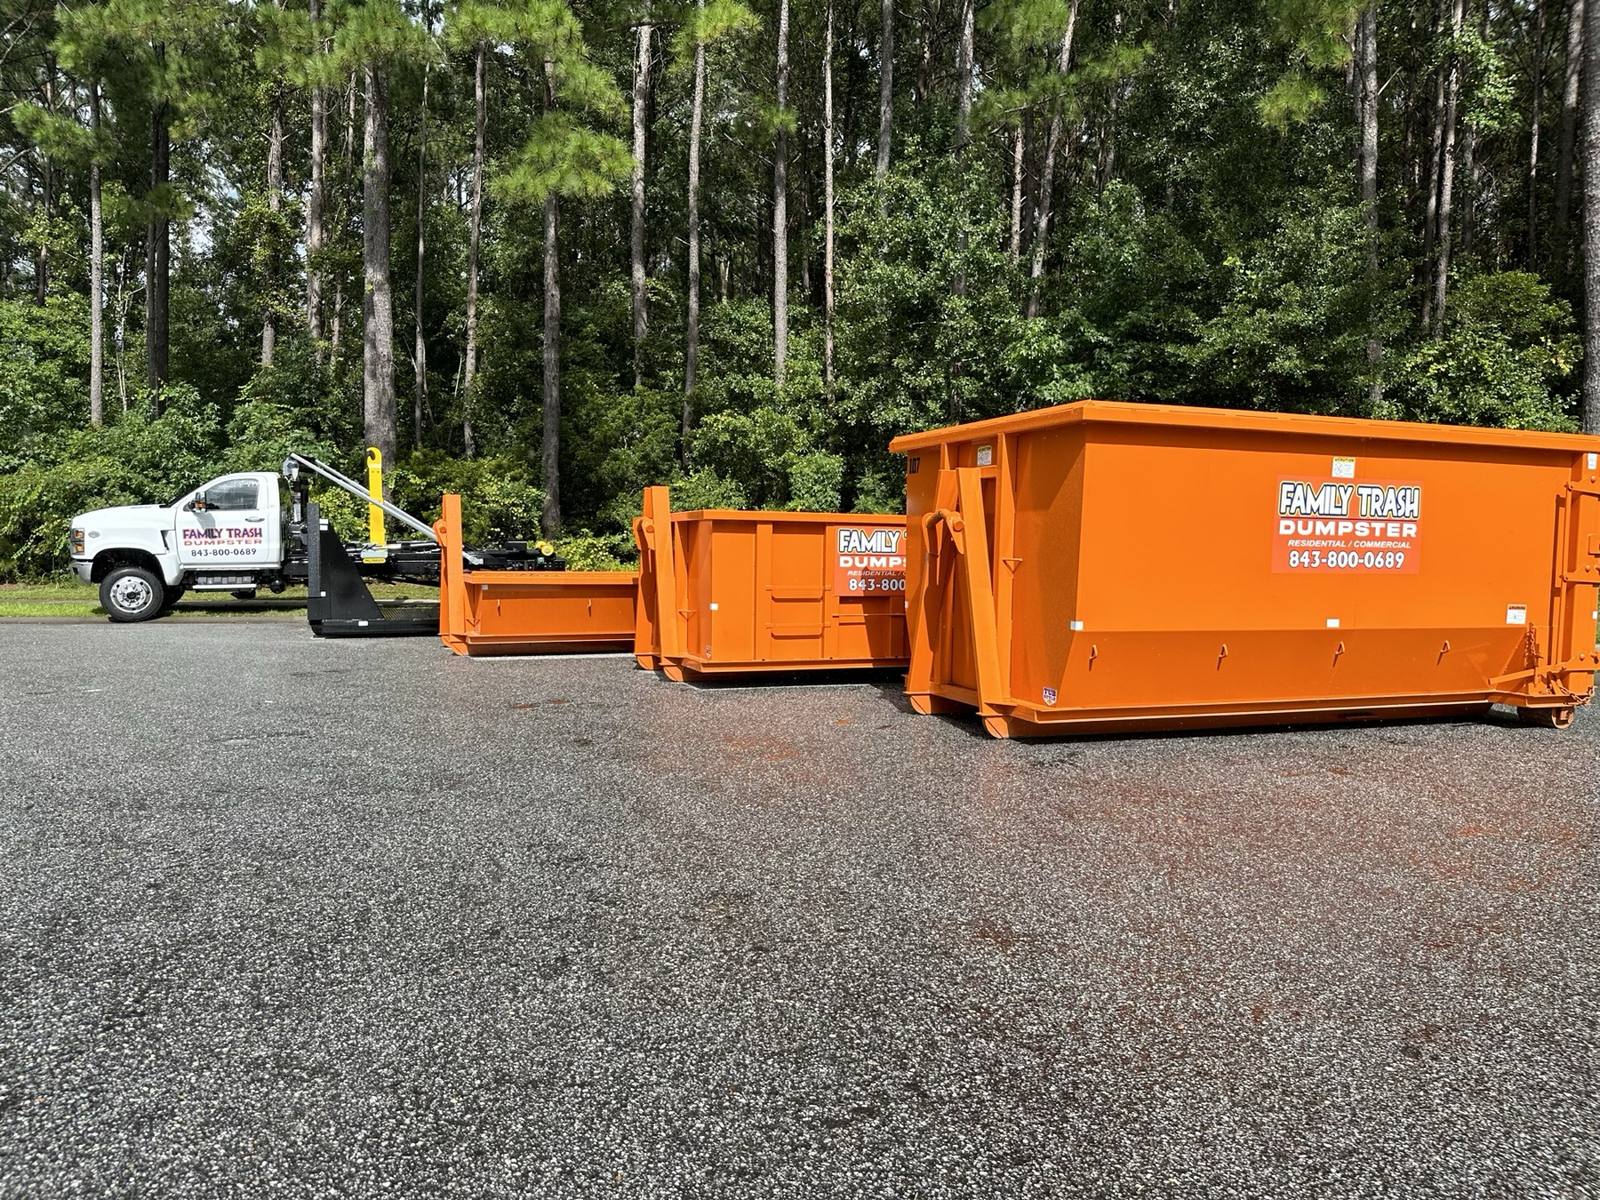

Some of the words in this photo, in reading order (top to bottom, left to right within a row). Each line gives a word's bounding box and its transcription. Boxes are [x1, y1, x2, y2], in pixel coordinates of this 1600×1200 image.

[1279, 482, 1354, 517] FAMILY
[1356, 485, 1421, 519] TRASH
[182, 528, 223, 539] FAMILY
[226, 527, 263, 538] TRASH
[1279, 520, 1418, 538] DUMPSTER
[838, 529, 901, 554] FAMILY
[1288, 539, 1347, 548] RESIDENTIAL
[1353, 541, 1412, 549] COMMERCIAL
[191, 548, 257, 557] 843-800-0689
[1289, 550, 1406, 569] 843-800-0689
